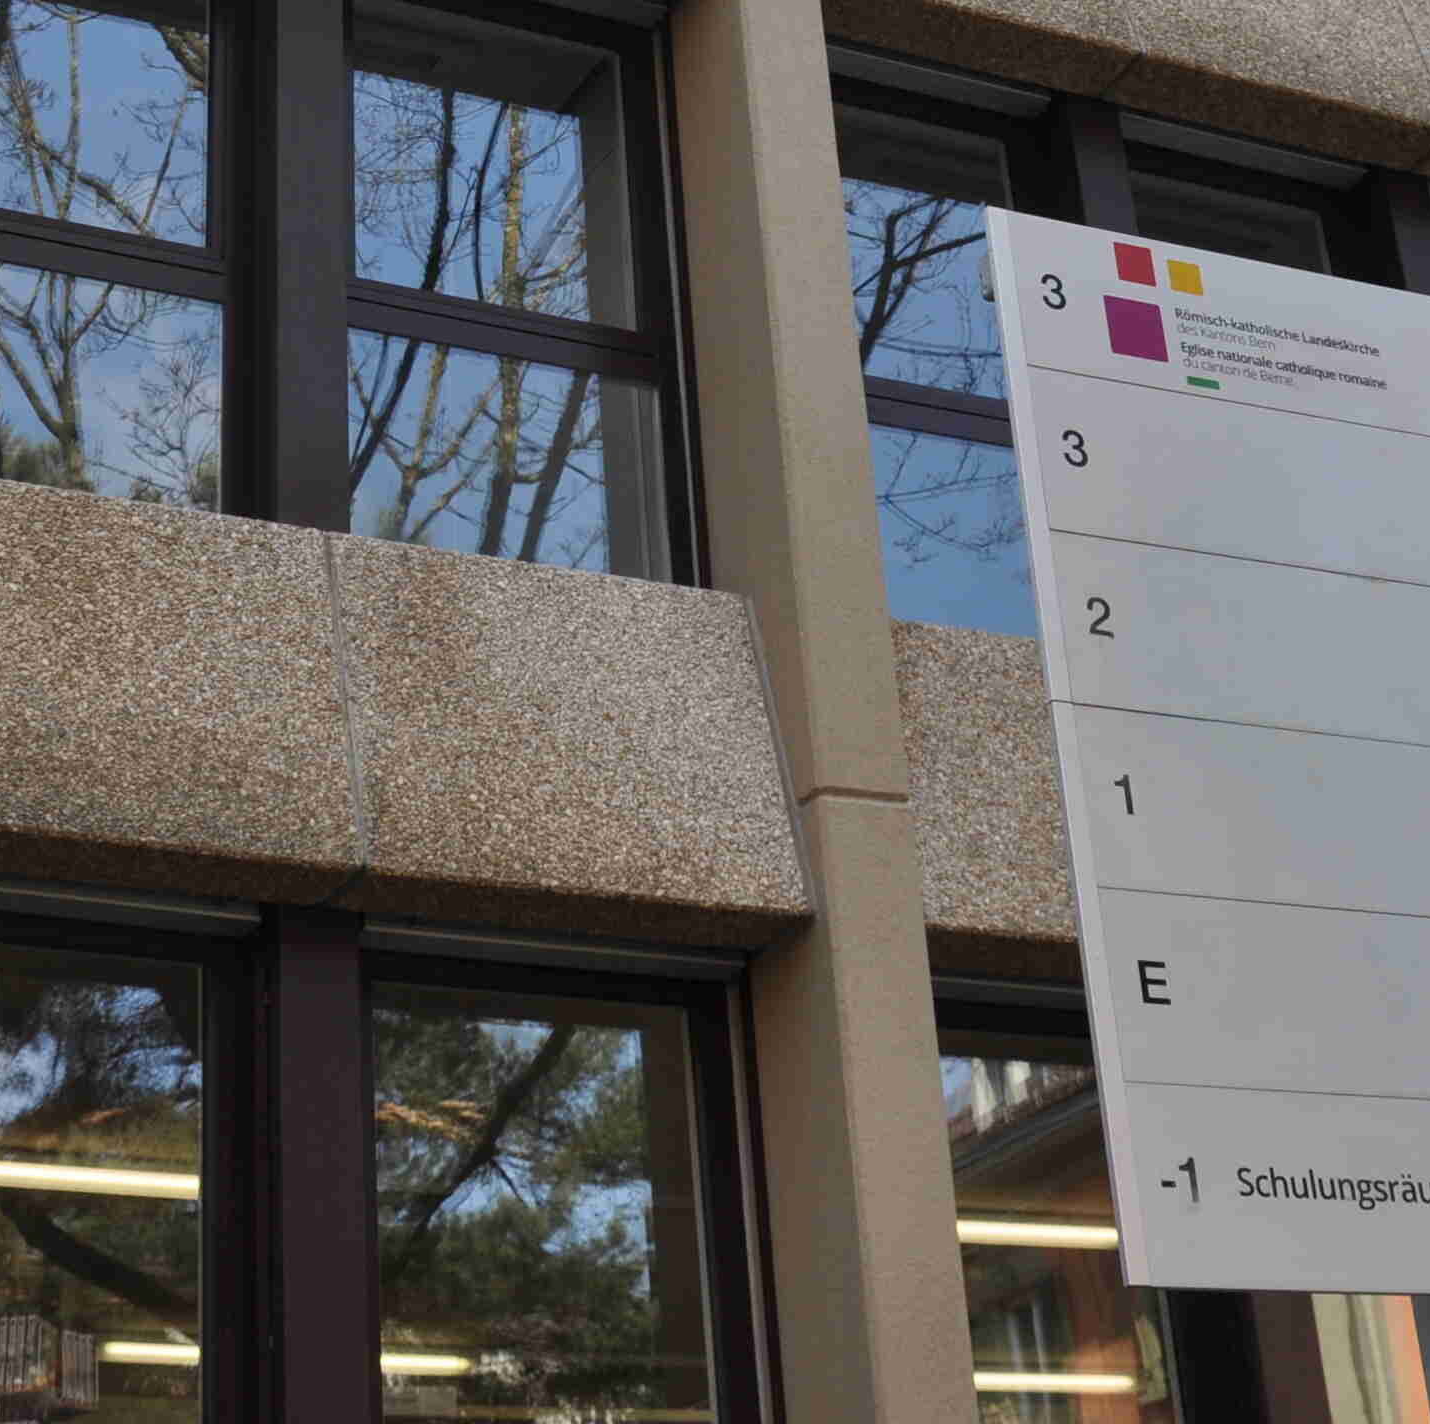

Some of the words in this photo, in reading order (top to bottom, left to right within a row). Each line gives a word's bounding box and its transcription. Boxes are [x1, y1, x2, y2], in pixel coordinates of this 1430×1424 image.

[1041, 273, 1066, 311] 3
[1174, 305, 1300, 341] Römisch-katholische
[1302, 331, 1380, 357] Landeskirche
[1178, 323, 1198, 336] des
[1201, 327, 1246, 344] Kantons
[1250, 337, 1276, 351] Bern
[1180, 341, 1215, 357] Eglise
[1217, 350, 1273, 369] nationale
[1275, 360, 1336, 381] catholique
[1339, 372, 1387, 390] romaine
[1183, 358, 1198, 369] du
[1201, 361, 1240, 376] canton
[1243, 367, 1258, 380] de
[1260, 370, 1294, 385] Berne
[1062, 429, 1089, 468] 3
[1087, 596, 1114, 640] 2
[1114, 774, 1135, 816] 1
[1137, 959, 1172, 1006] E
[1161, 1156, 1200, 1204] -1
